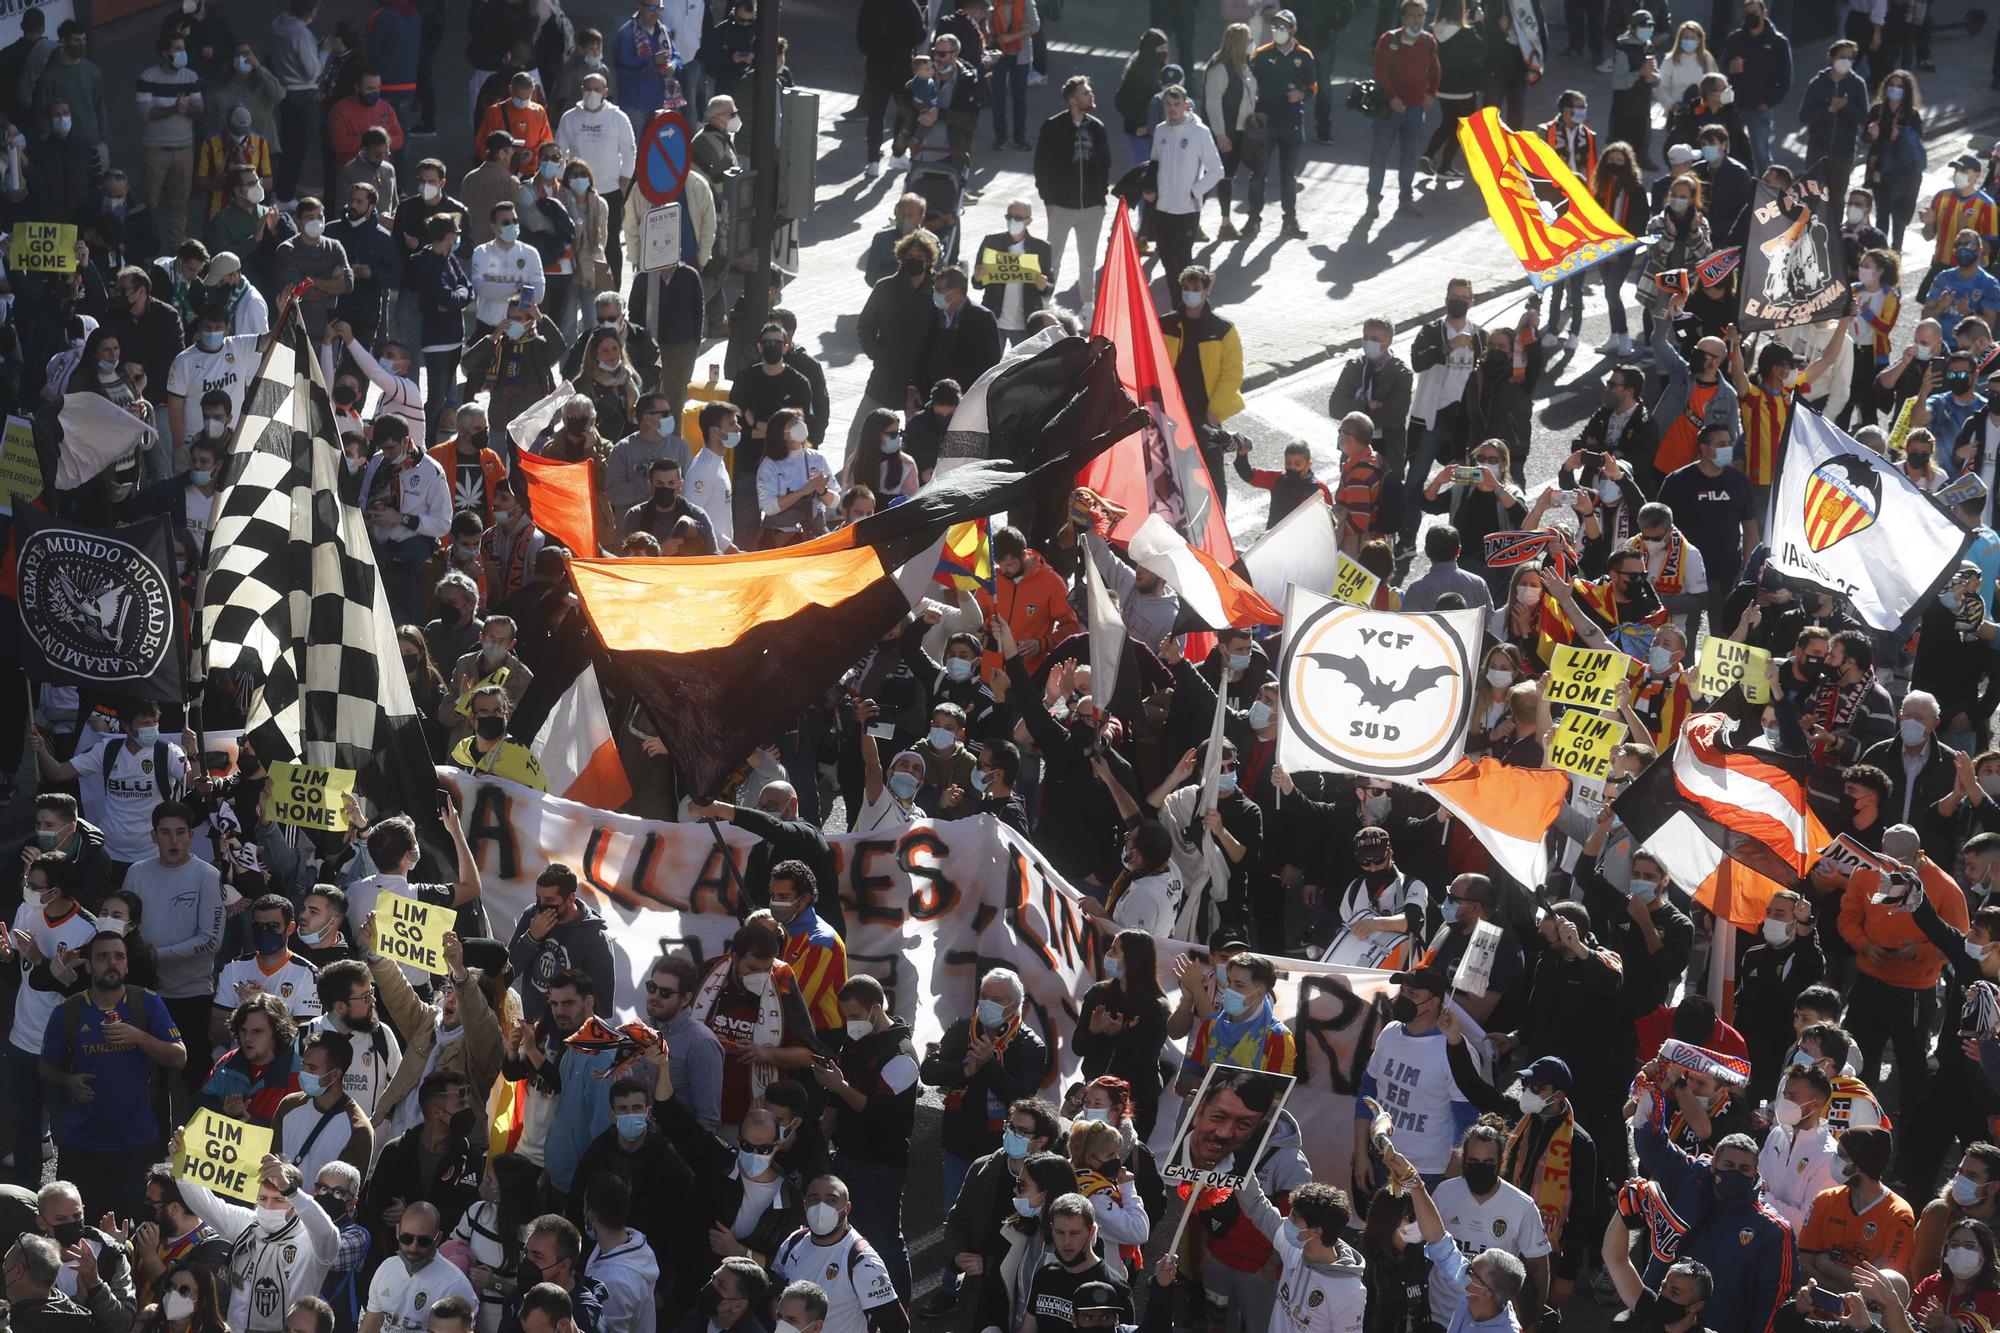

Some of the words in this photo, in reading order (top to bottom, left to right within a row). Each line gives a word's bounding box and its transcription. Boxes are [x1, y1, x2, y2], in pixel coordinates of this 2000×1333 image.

[28, 226, 57, 239] LIM
[30, 240, 54, 253] GO
[18, 254, 66, 267] HOME
[995, 253, 1019, 264] LIM
[989, 272, 1033, 281] HOME
[202, 372, 237, 391] bwin
[1698, 490, 1731, 501] FILA
[45, 537, 121, 563] MUNDO
[24, 544, 47, 610] KEMPE
[1338, 563, 1367, 590] LIM
[1338, 583, 1353, 597] GO
[125, 558, 165, 659] PUCHADES
[1358, 627, 1414, 650] VCF
[1567, 651, 1612, 671] LIM
[1717, 643, 1750, 664] LIM
[1572, 670, 1597, 683] GO
[1717, 661, 1744, 680] GO
[1547, 680, 1616, 706] HOME
[1701, 674, 1757, 700] HOE
[1349, 720, 1400, 741] SUD
[1568, 714, 1611, 740] LIM
[1572, 736, 1594, 751] GO
[1551, 745, 1608, 776] HOME
[290, 767, 329, 786] LIM
[290, 785, 322, 804] GO
[275, 802, 336, 826] HOME
[392, 899, 428, 926] LIM
[393, 921, 423, 942] GO
[380, 933, 437, 968] HOME
[713, 1026, 729, 1034] FAN
[732, 1030, 752, 1039] TOKE
[343, 1074, 368, 1083] ERRA
[1383, 1058, 1421, 1087] LIM
[1385, 1081, 1410, 1108] GO
[205, 1115, 243, 1145] LIM
[205, 1139, 237, 1164] GO
[182, 1154, 248, 1193] HOME
[1164, 1165, 1203, 1181] GAME
[1206, 1172, 1244, 1190] OVER
